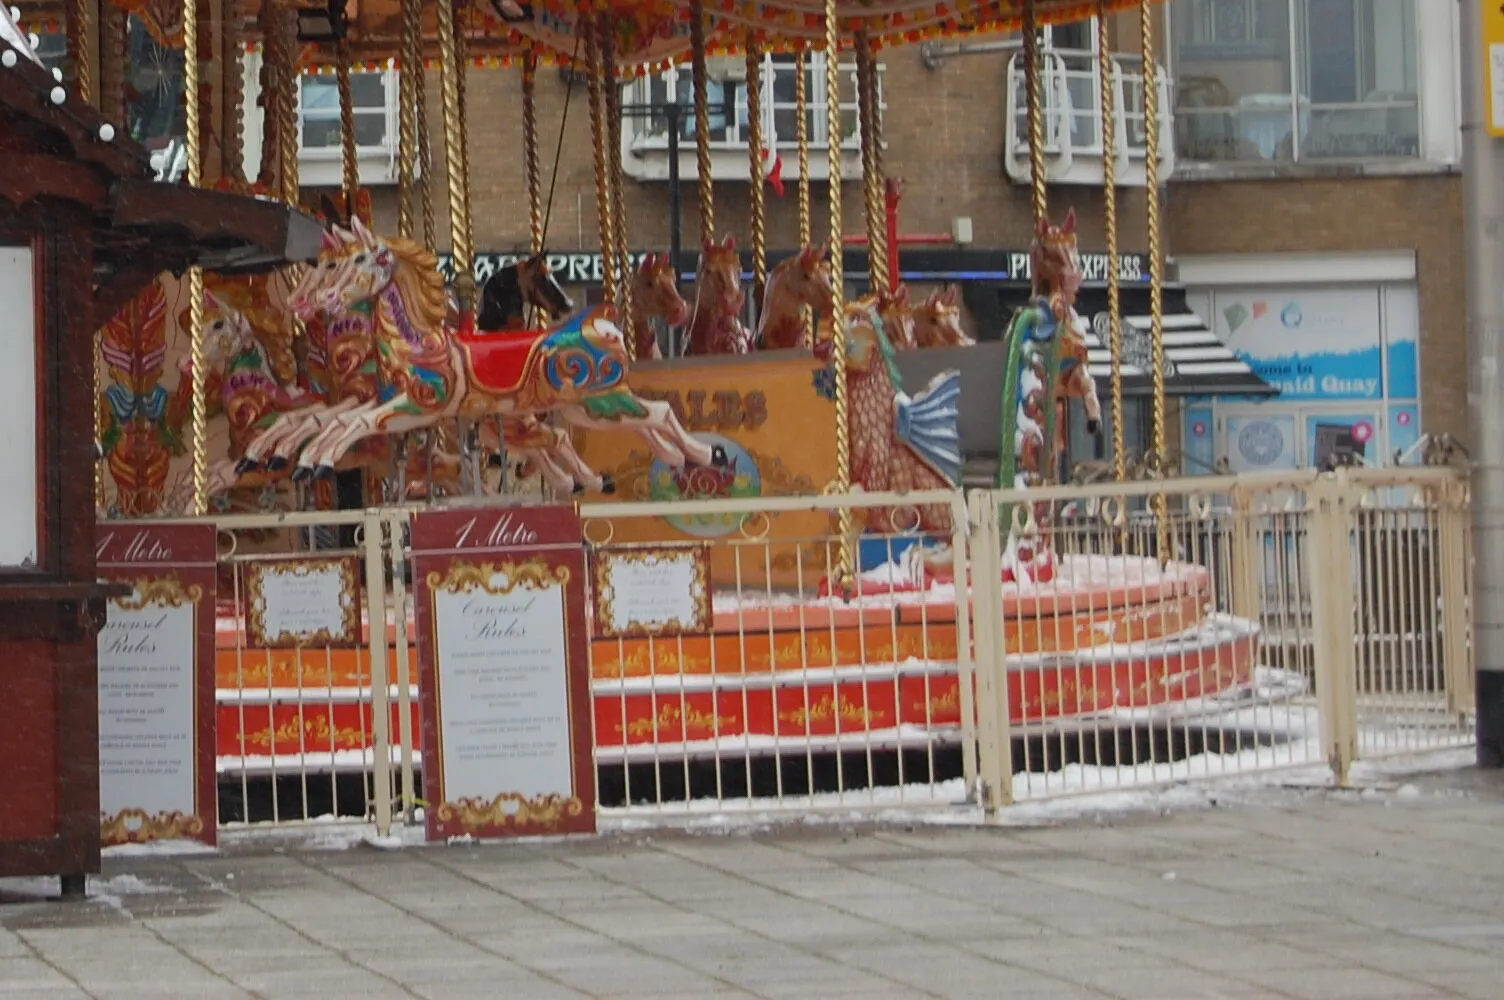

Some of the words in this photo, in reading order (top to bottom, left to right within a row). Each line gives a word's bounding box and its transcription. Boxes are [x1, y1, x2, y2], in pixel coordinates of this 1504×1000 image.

[1321, 375, 1378, 396] Quay
[462, 595, 537, 618] Carousel
[105, 613, 168, 630] arousel
[464, 617, 527, 640] Rules
[104, 633, 157, 654] Rules
